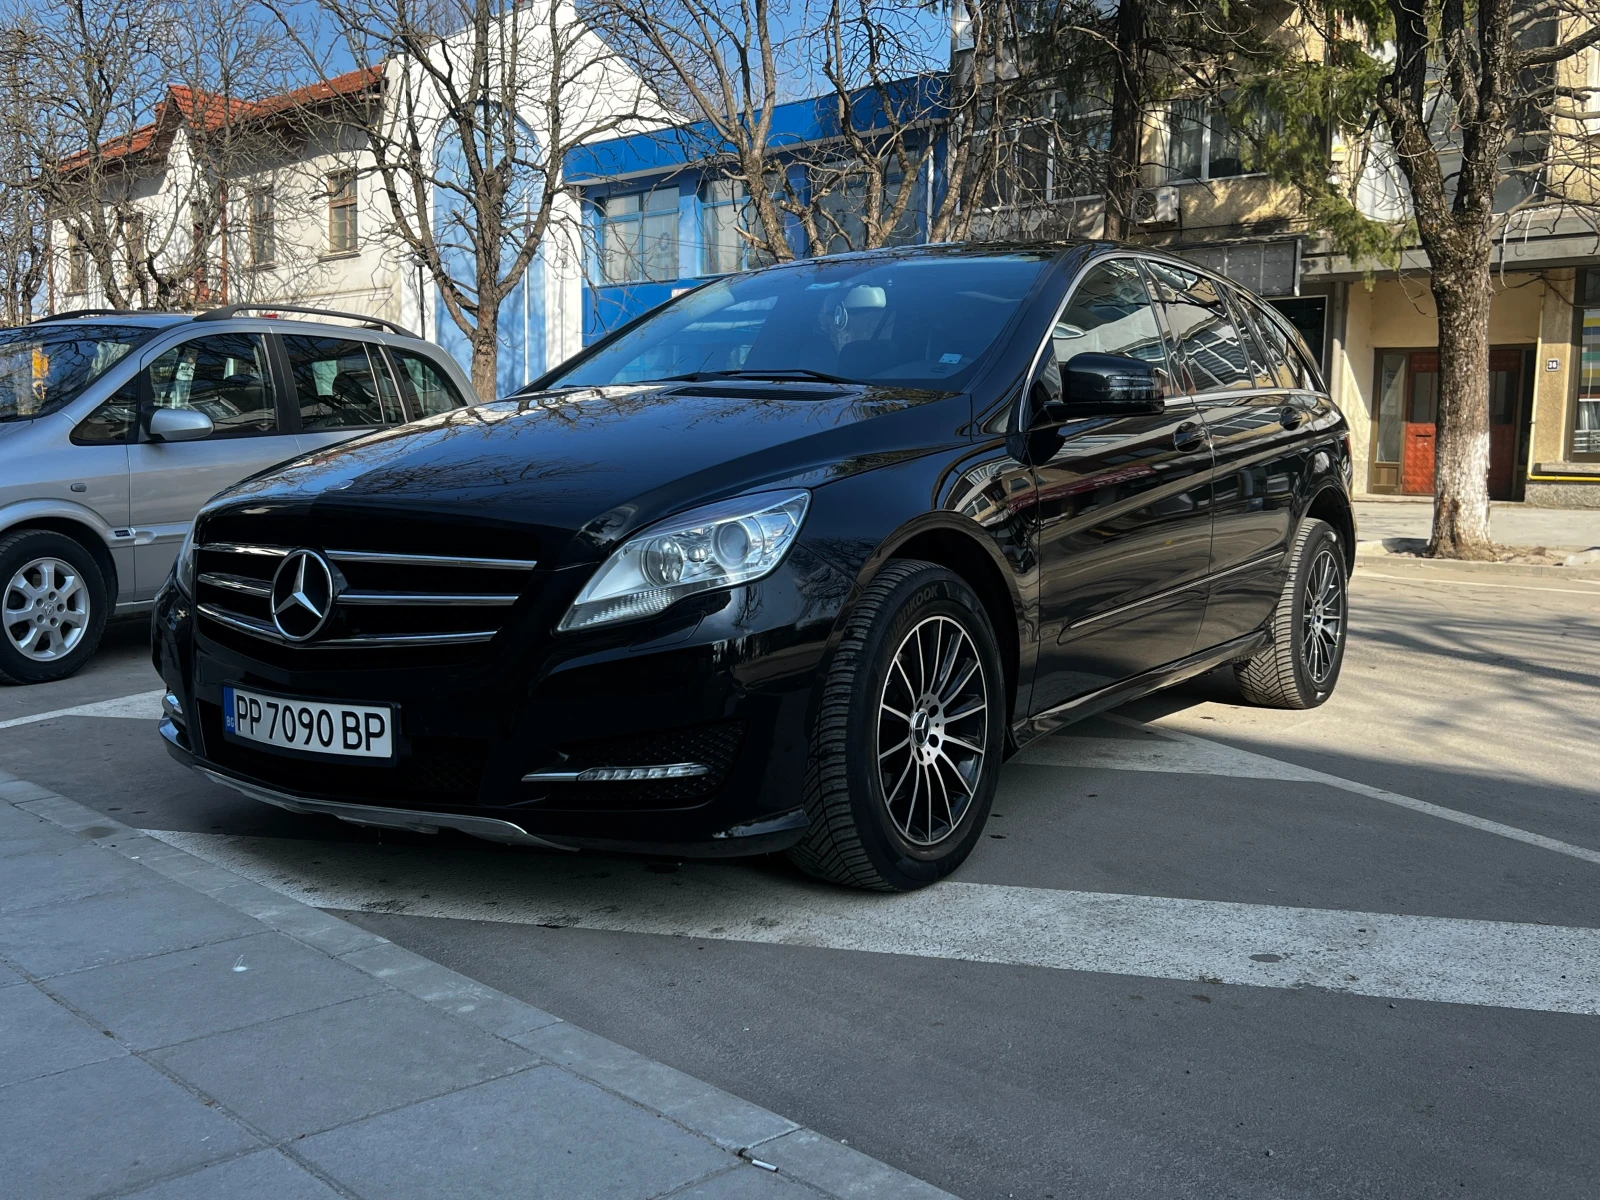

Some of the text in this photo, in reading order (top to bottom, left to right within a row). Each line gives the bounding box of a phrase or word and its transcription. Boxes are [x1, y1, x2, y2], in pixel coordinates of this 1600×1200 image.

[226, 715, 235, 728] BG
[236, 694, 386, 751] PP 7090 BP
